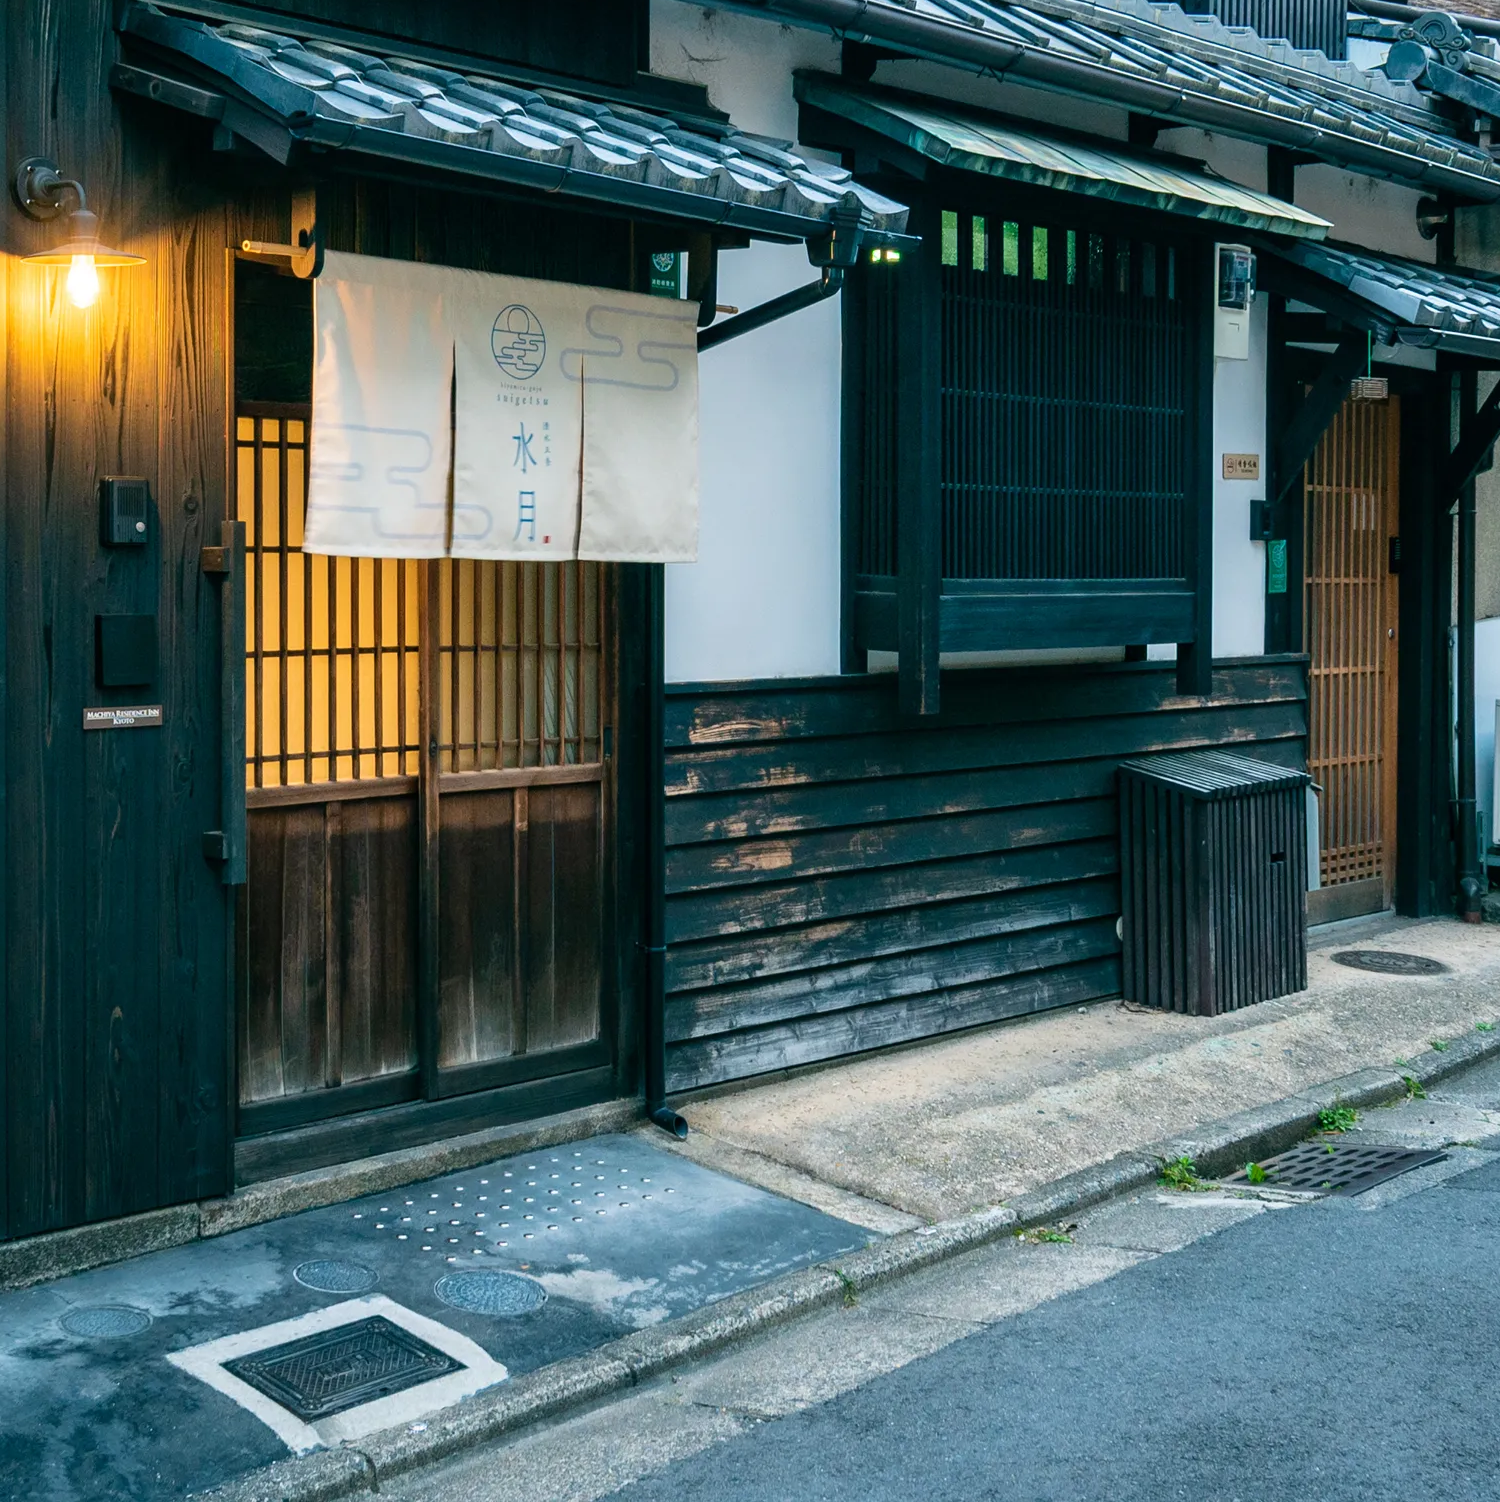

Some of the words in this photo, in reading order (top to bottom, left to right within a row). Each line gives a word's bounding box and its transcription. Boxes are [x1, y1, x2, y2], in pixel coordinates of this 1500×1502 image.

[496, 393, 549, 406] suigetsu
[512, 421, 537, 542] 水月
[115, 709, 147, 718] RESIDENCE
[147, 708, 160, 717] INN
[113, 717, 135, 725] KYOTO
